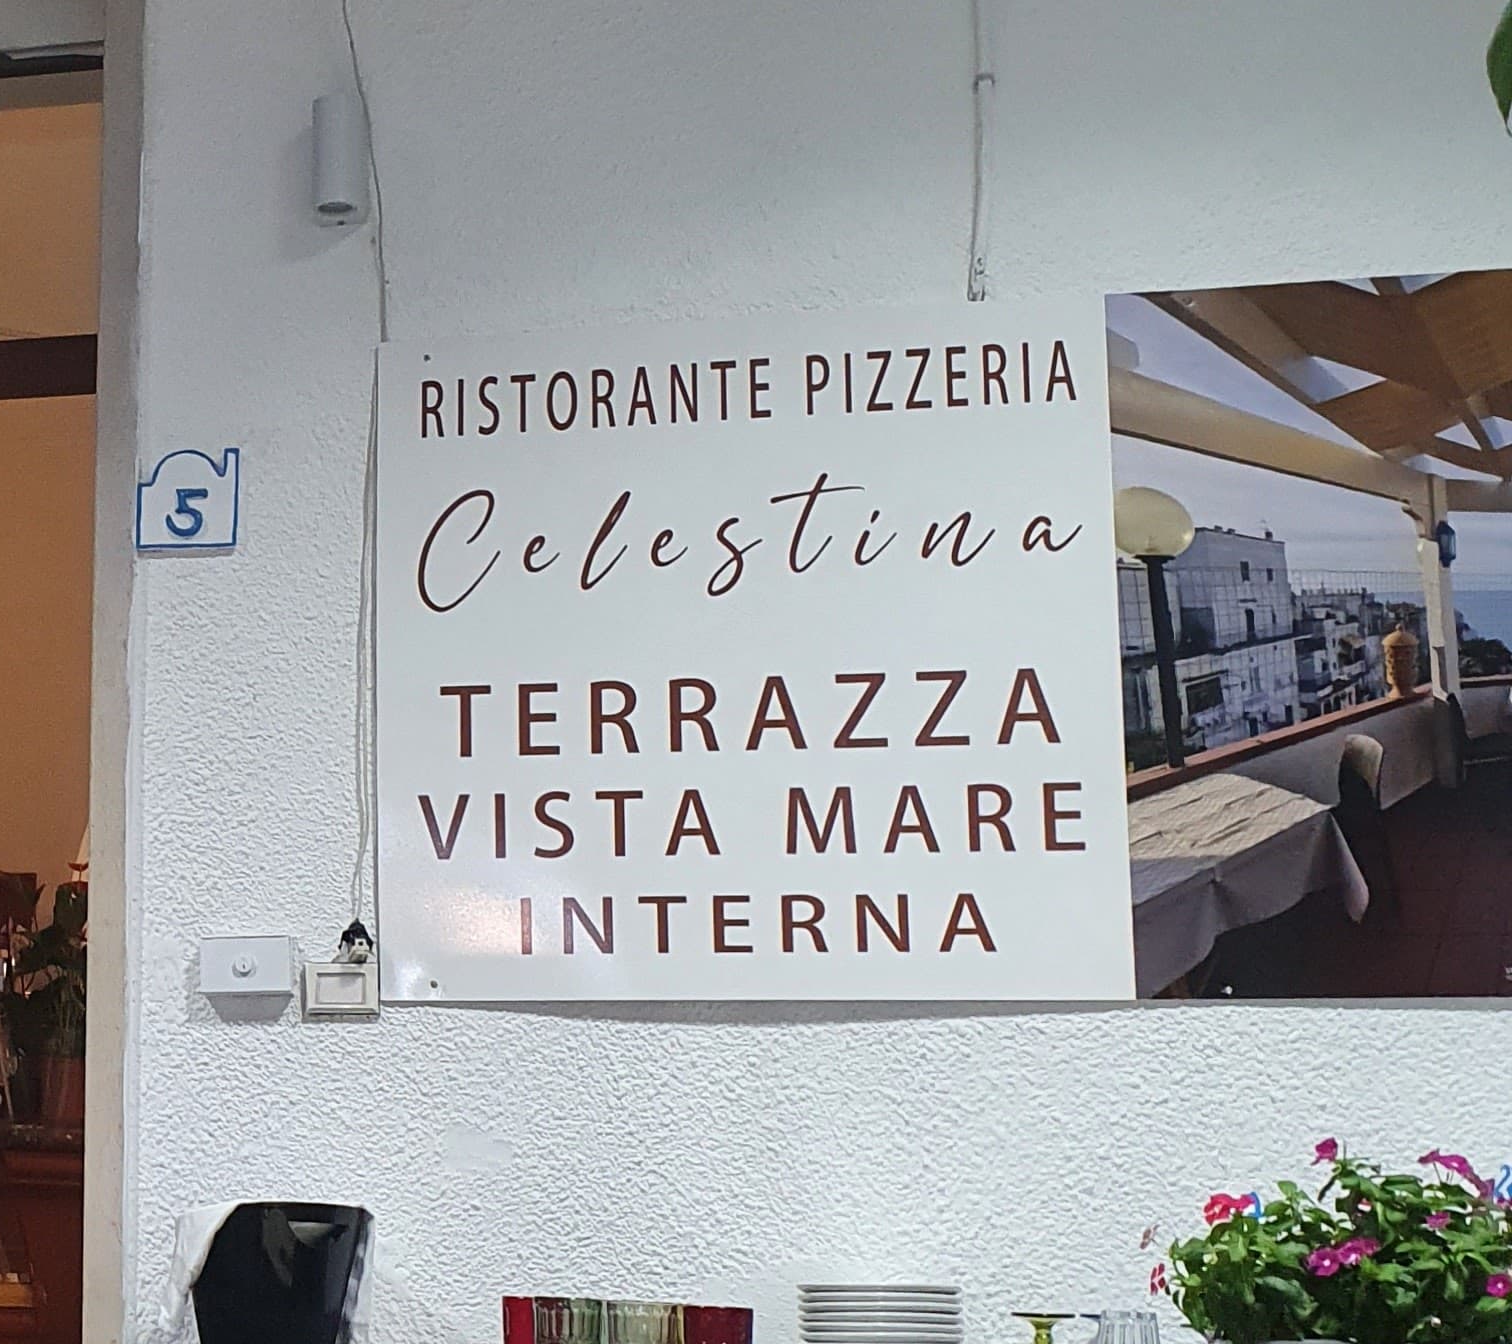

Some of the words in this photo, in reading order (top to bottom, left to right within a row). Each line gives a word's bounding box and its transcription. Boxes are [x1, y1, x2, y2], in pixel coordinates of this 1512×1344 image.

[421, 357, 772, 439] RISTORANTE
[805, 340, 1077, 417] PIZZERIA
[165, 487, 209, 538] 5
[417, 472, 1083, 613] Celestina
[439, 667, 1062, 758] TERRAZZA
[417, 788, 721, 860] VISTA
[786, 781, 1086, 855] MARE
[519, 892, 998, 956] INTERNA
